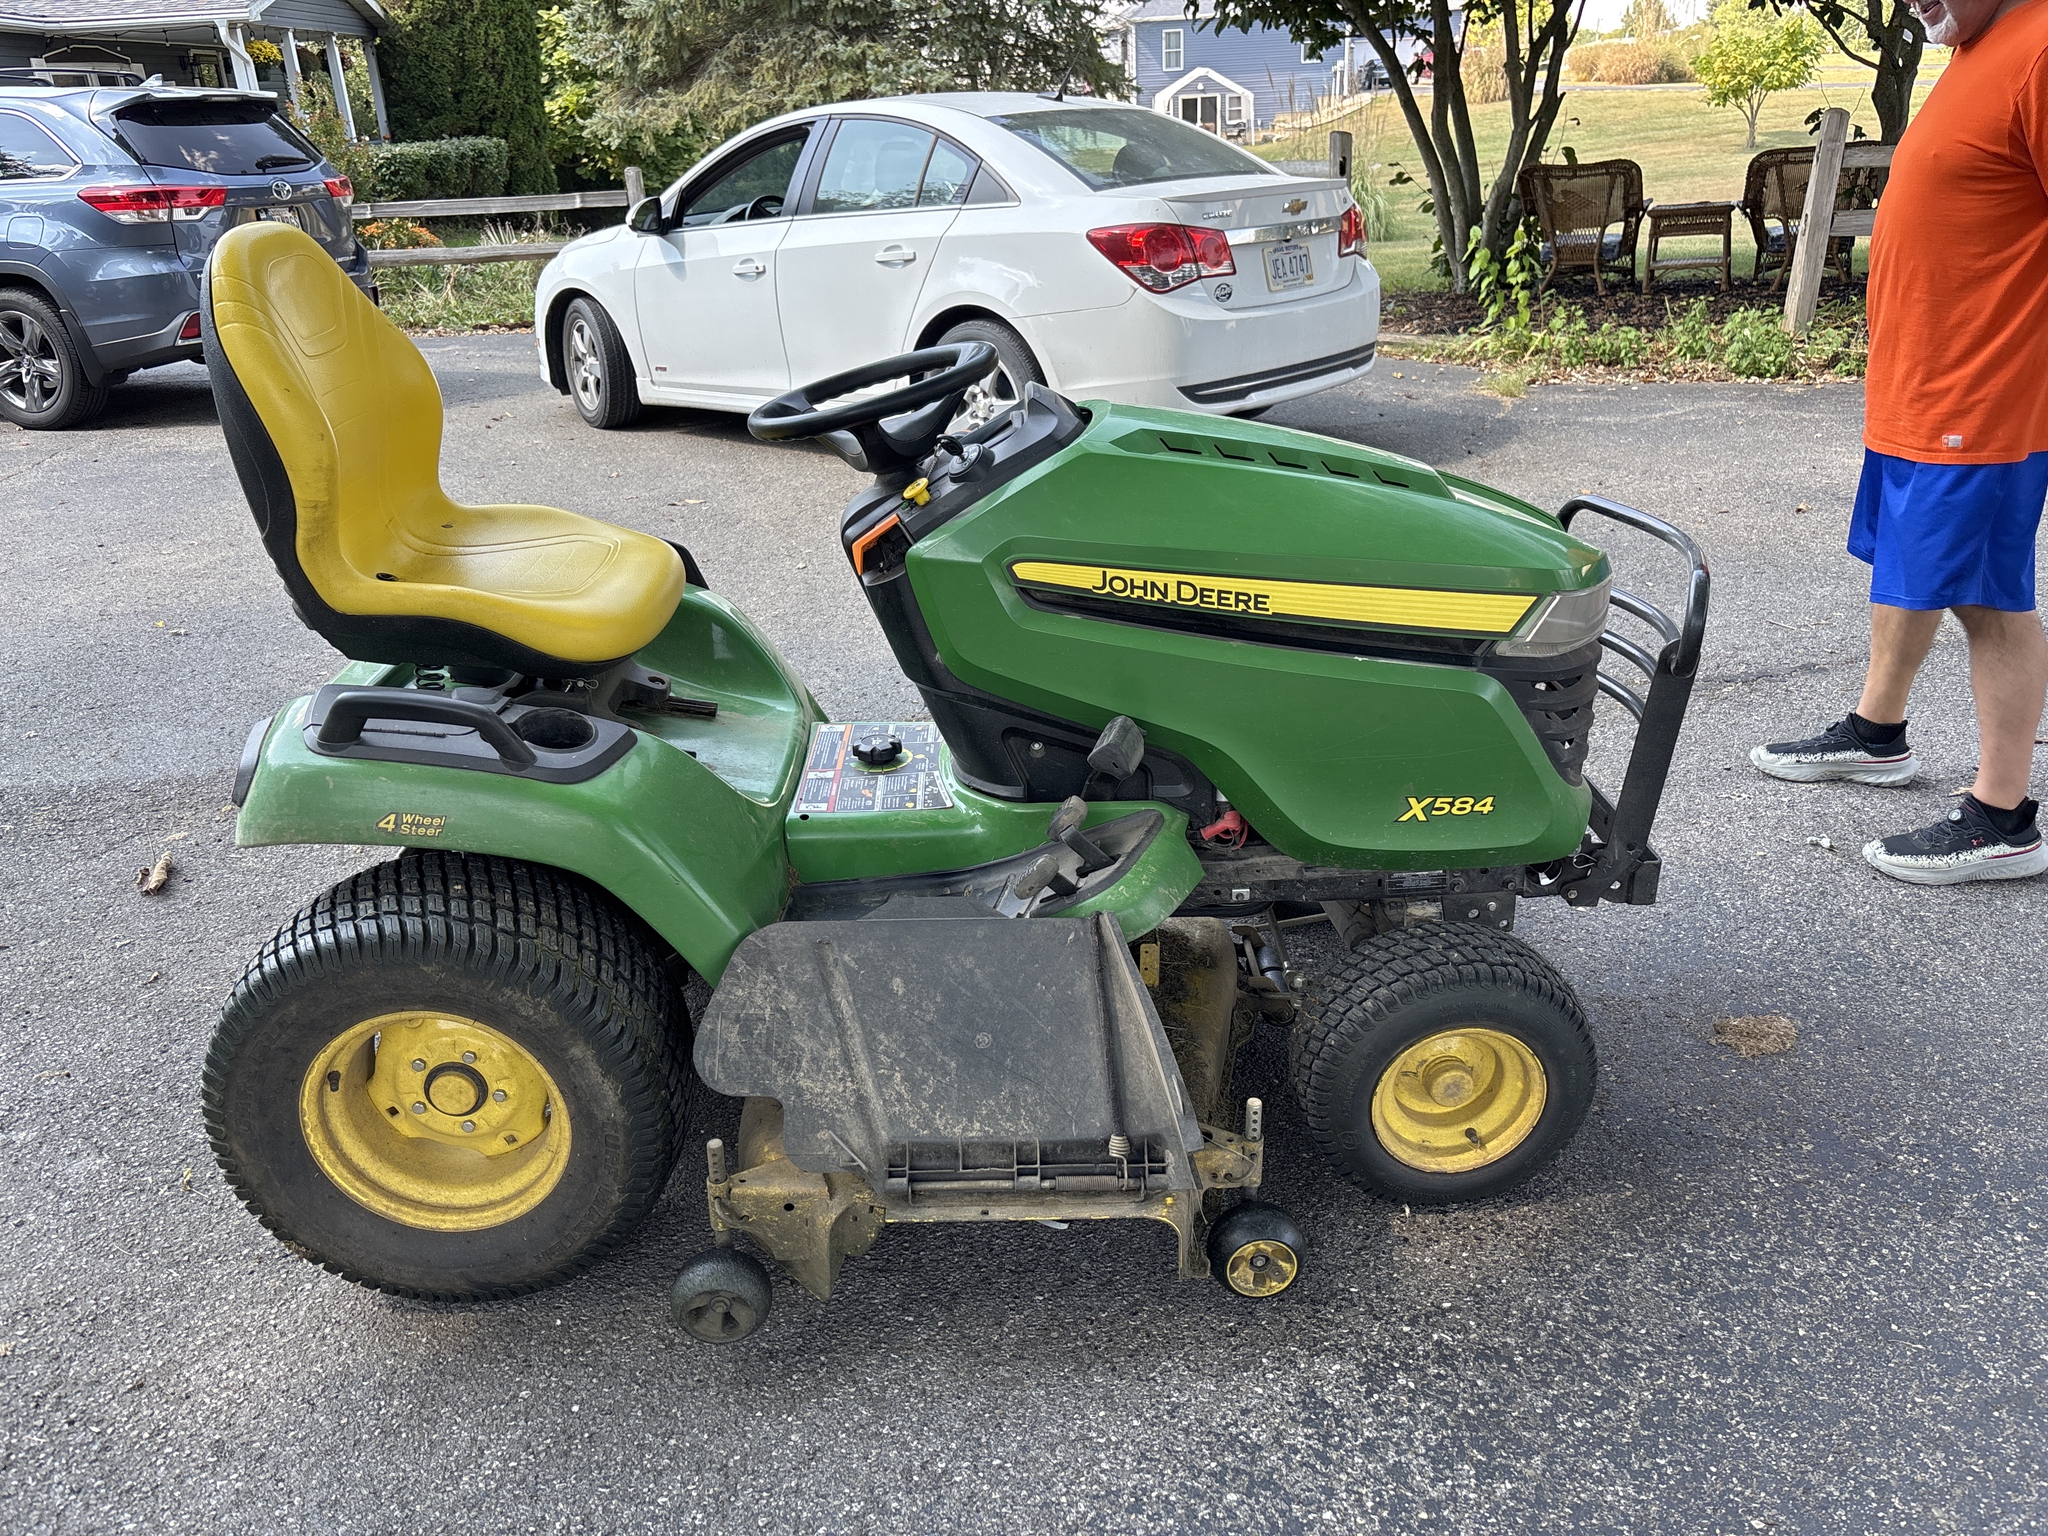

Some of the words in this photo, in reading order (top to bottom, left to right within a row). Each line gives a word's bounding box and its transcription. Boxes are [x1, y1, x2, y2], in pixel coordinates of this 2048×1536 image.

[1272, 258, 1288, 280] JEA
[1289, 253, 1309, 277] 4747
[1092, 570, 1168, 599] JOHN
[1176, 580, 1270, 612] DEERE
[1395, 795, 1495, 822] X584
[377, 813, 397, 832] 4
[402, 813, 446, 827] Wheel
[401, 823, 443, 837] Steer
[602, 1120, 621, 1181] TURF
[532, 1185, 614, 1266] MASTER
